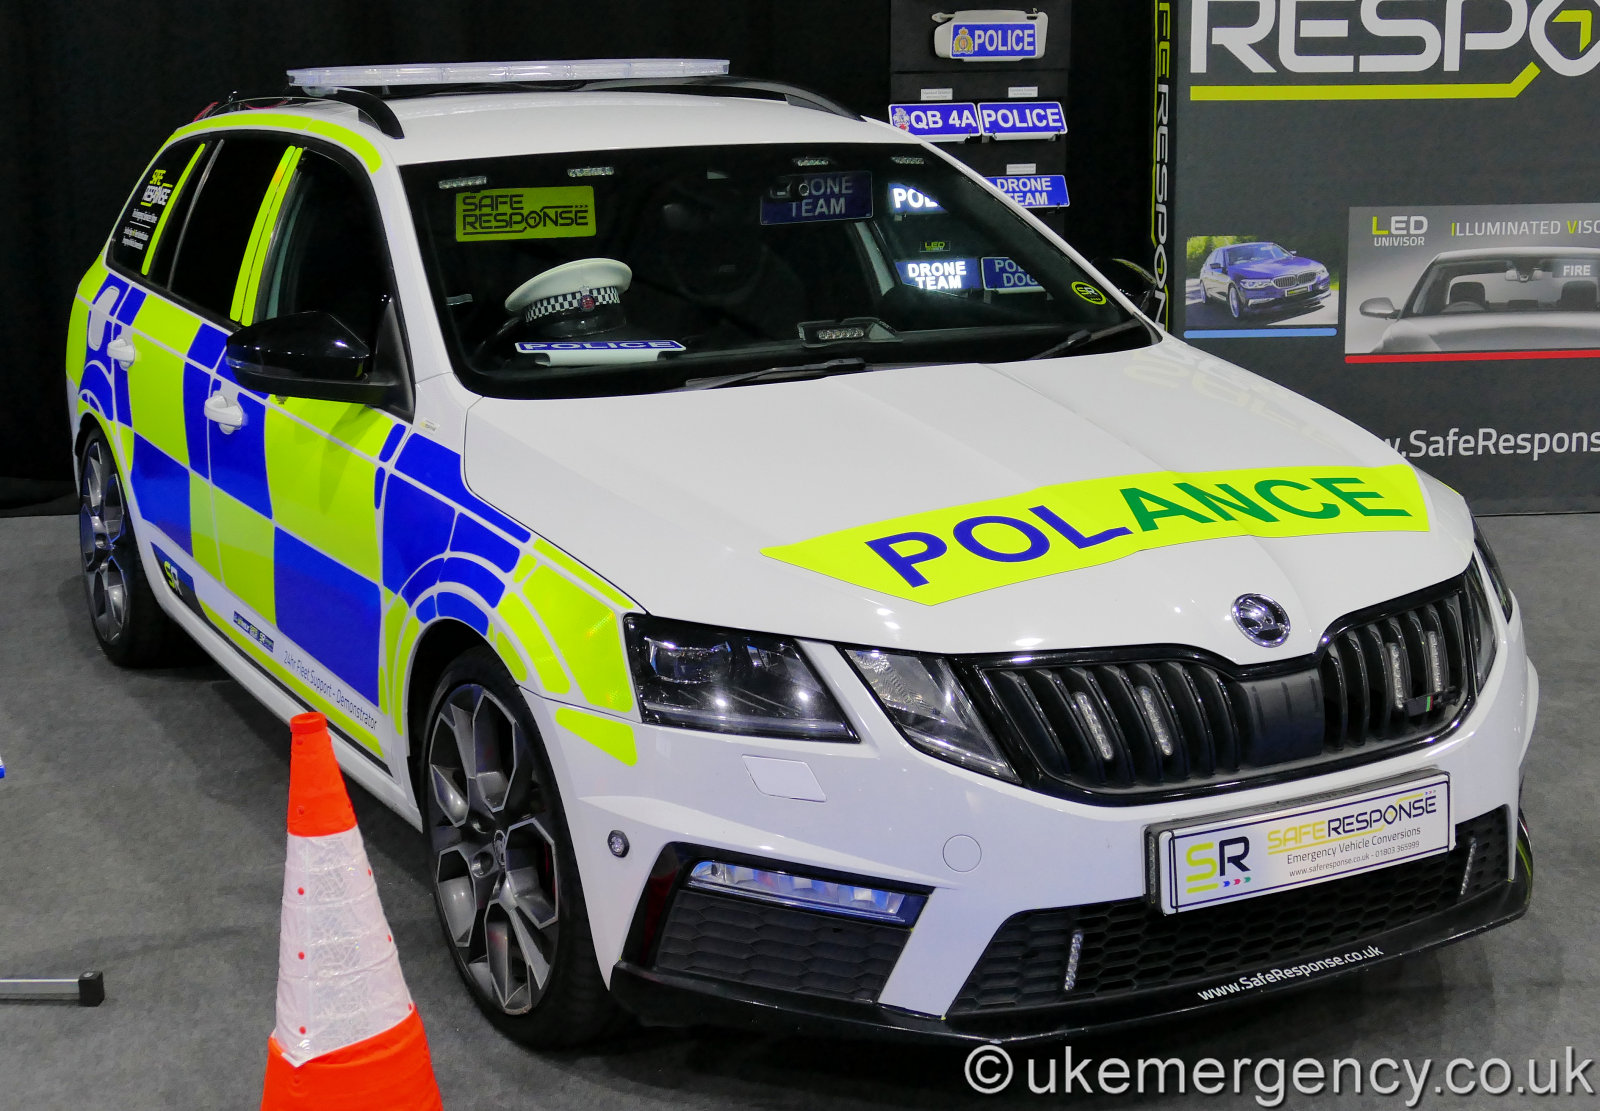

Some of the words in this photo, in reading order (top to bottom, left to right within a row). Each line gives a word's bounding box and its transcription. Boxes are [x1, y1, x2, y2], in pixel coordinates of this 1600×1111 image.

[974, 29, 1034, 52] POLICE
[911, 110, 943, 130] QB
[948, 109, 977, 128] 4A
[982, 108, 1062, 128] POLICE
[996, 178, 1052, 193] DRONE
[462, 193, 524, 213] SAFE
[788, 196, 846, 217] TEAM
[462, 209, 589, 230] RESPONSE
[1372, 215, 1429, 235] LED
[1451, 221, 1561, 236] ILLUMINATED
[1374, 236, 1425, 247] UNIVISOR
[907, 261, 967, 278] DRONE
[1563, 265, 1591, 277] FIRE
[915, 275, 962, 290] TEAM
[522, 341, 676, 350] POLICE
[284, 650, 297, 669] 24hr
[297, 660, 310, 681] Fleet
[310, 670, 332, 698] Support
[336, 689, 377, 731] Demonstrator
[1287, 846, 1337, 865] Emergency
[1338, 838, 1370, 853] Vehicle
[1371, 826, 1421, 846] Conversions
[1186, 836, 1251, 883] SR
[1289, 853, 1370, 878] www.saferesponse.co.uk
[1375, 846, 1396, 858] 01803
[1396, 841, 1420, 853] 365999
[1197, 944, 1384, 1001] www.SafeResponse.co.uk
